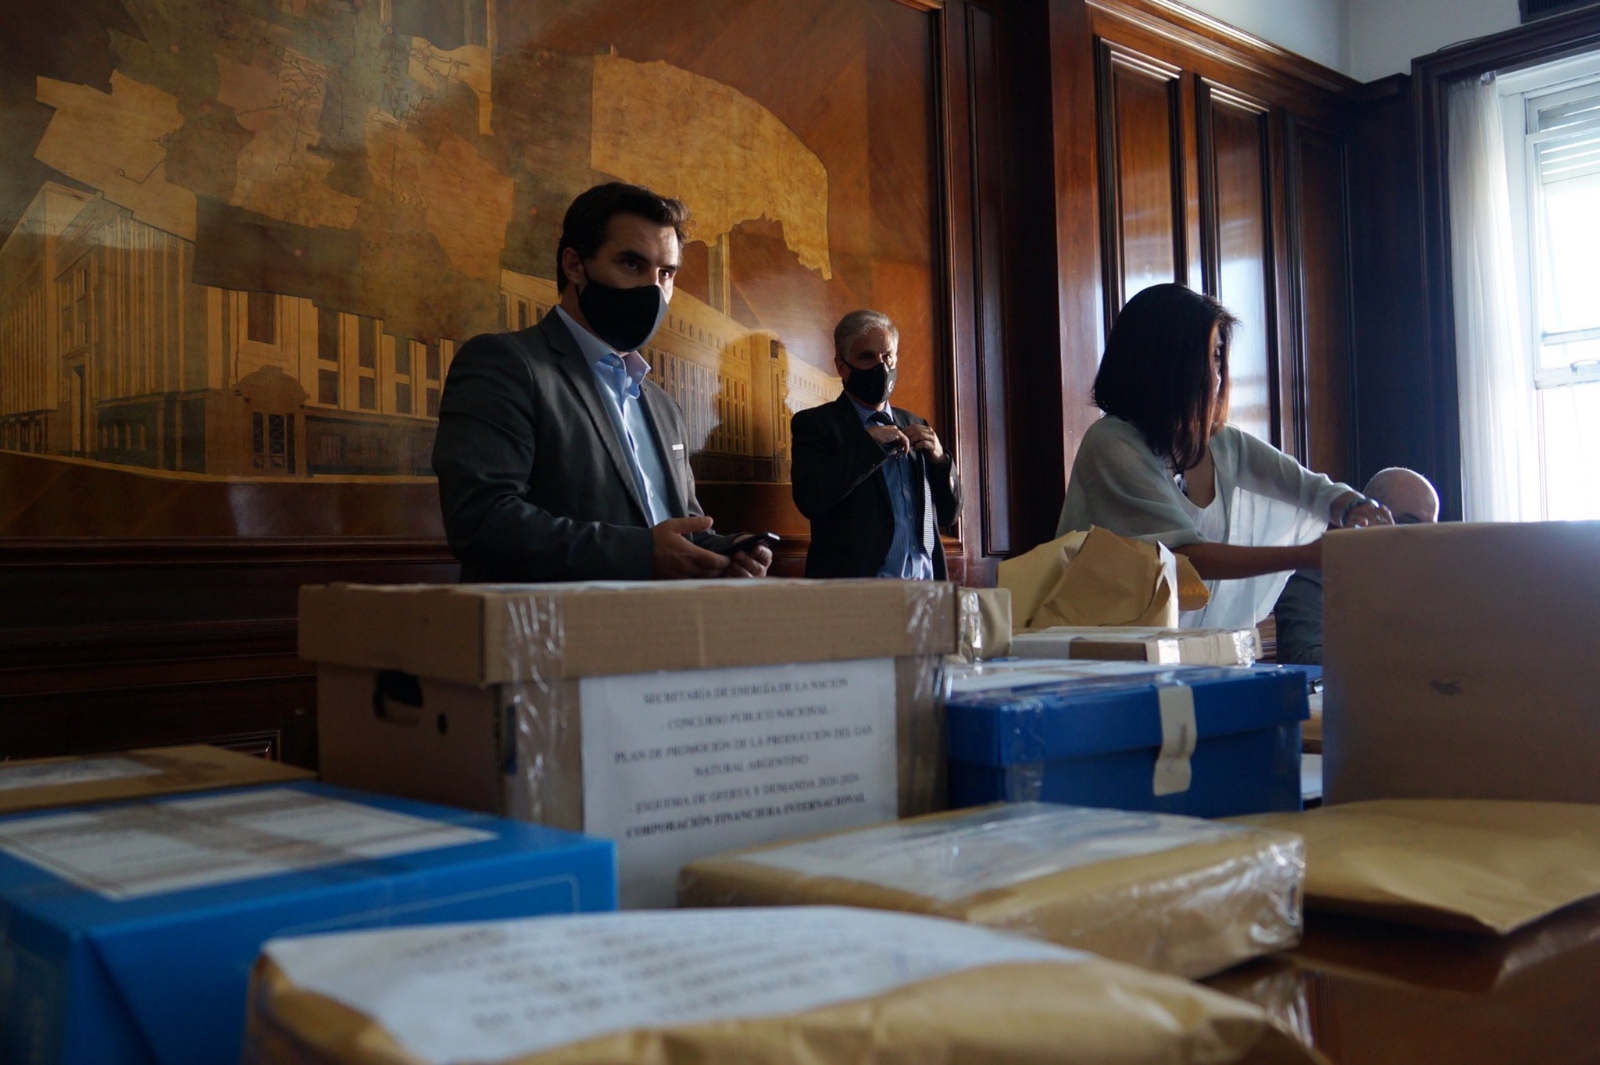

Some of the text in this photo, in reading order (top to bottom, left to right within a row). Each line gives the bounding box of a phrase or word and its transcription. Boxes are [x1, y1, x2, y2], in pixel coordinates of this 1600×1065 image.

[713, 686, 727, 699] DE
[777, 680, 791, 693] DE
[794, 678, 809, 692] LA
[775, 703, 827, 720] NACIONAL
[614, 749, 645, 764] PLAN
[648, 747, 662, 760] DE
[733, 737, 745, 751] DE
[748, 735, 763, 749] LA
[834, 725, 850, 739] DEL
[853, 722, 874, 737] GAS
[694, 752, 809, 776] NATURAL ARGENTINO
[692, 792, 706, 806] DE
[708, 786, 751, 804] OFERTA
[762, 777, 815, 796] DEMANDA
[713, 803, 782, 825] FINANCIERA
[783, 791, 865, 815] INTERNACIONAL
